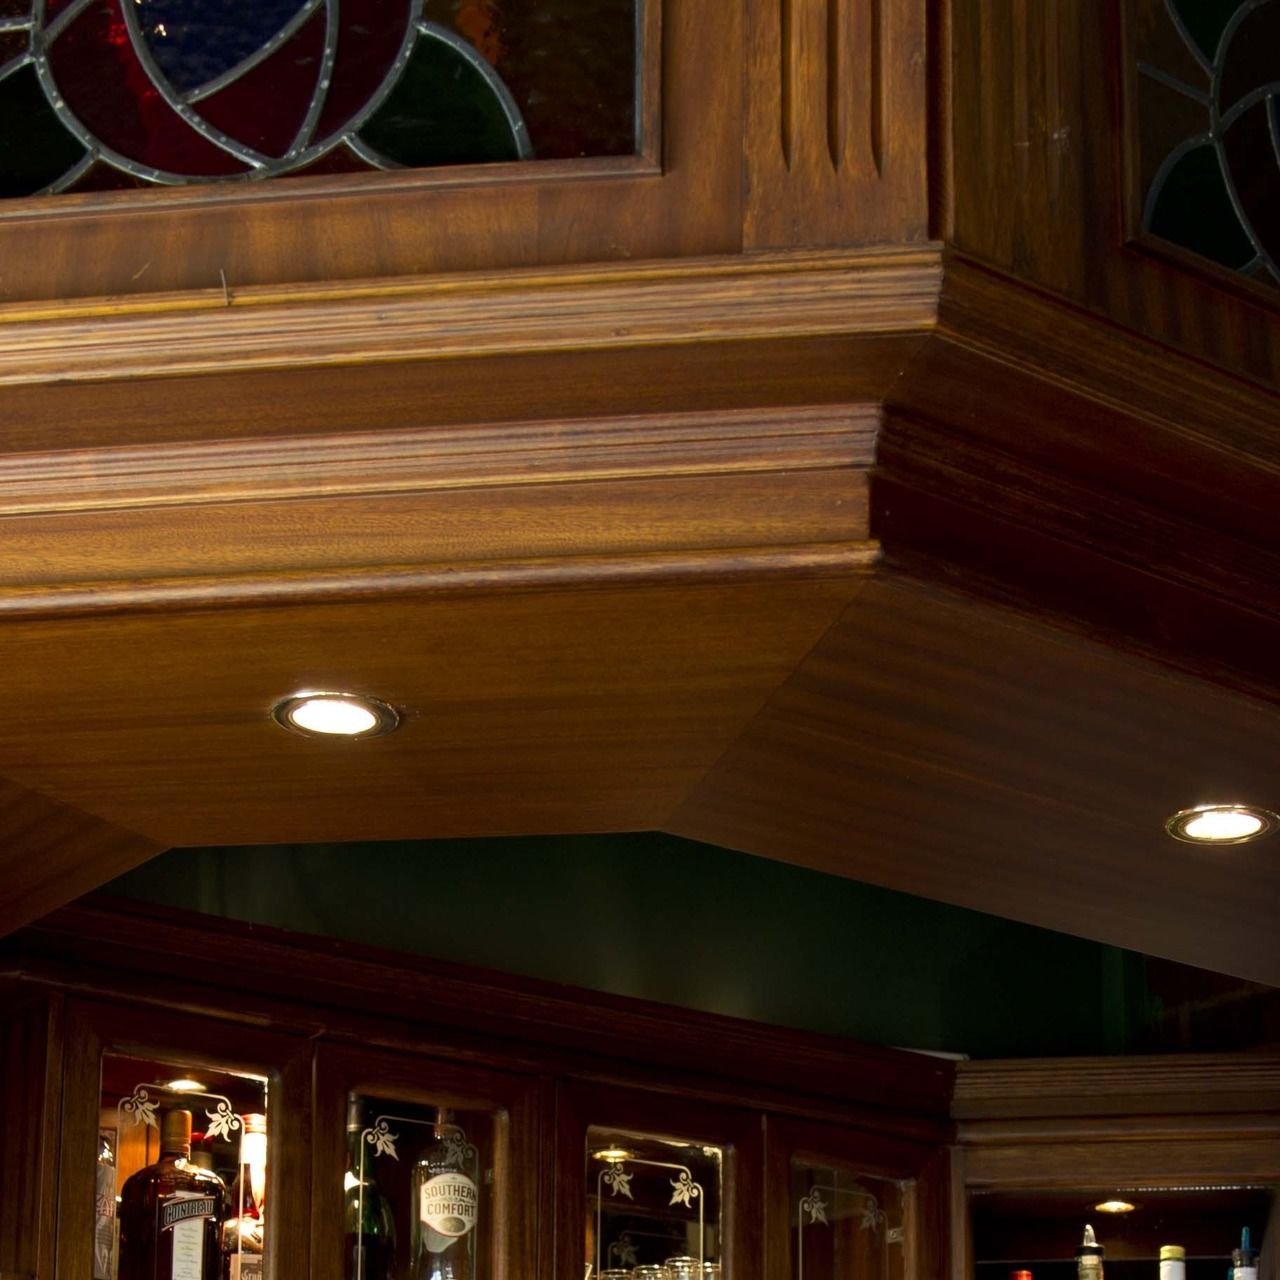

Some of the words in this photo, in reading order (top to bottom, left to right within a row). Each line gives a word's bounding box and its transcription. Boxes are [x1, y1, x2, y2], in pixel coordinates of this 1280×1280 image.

[424, 1184, 477, 1200] SOUTHERN
[164, 1200, 214, 1226] COINTREAU
[427, 1203, 475, 1217] COMFORT
